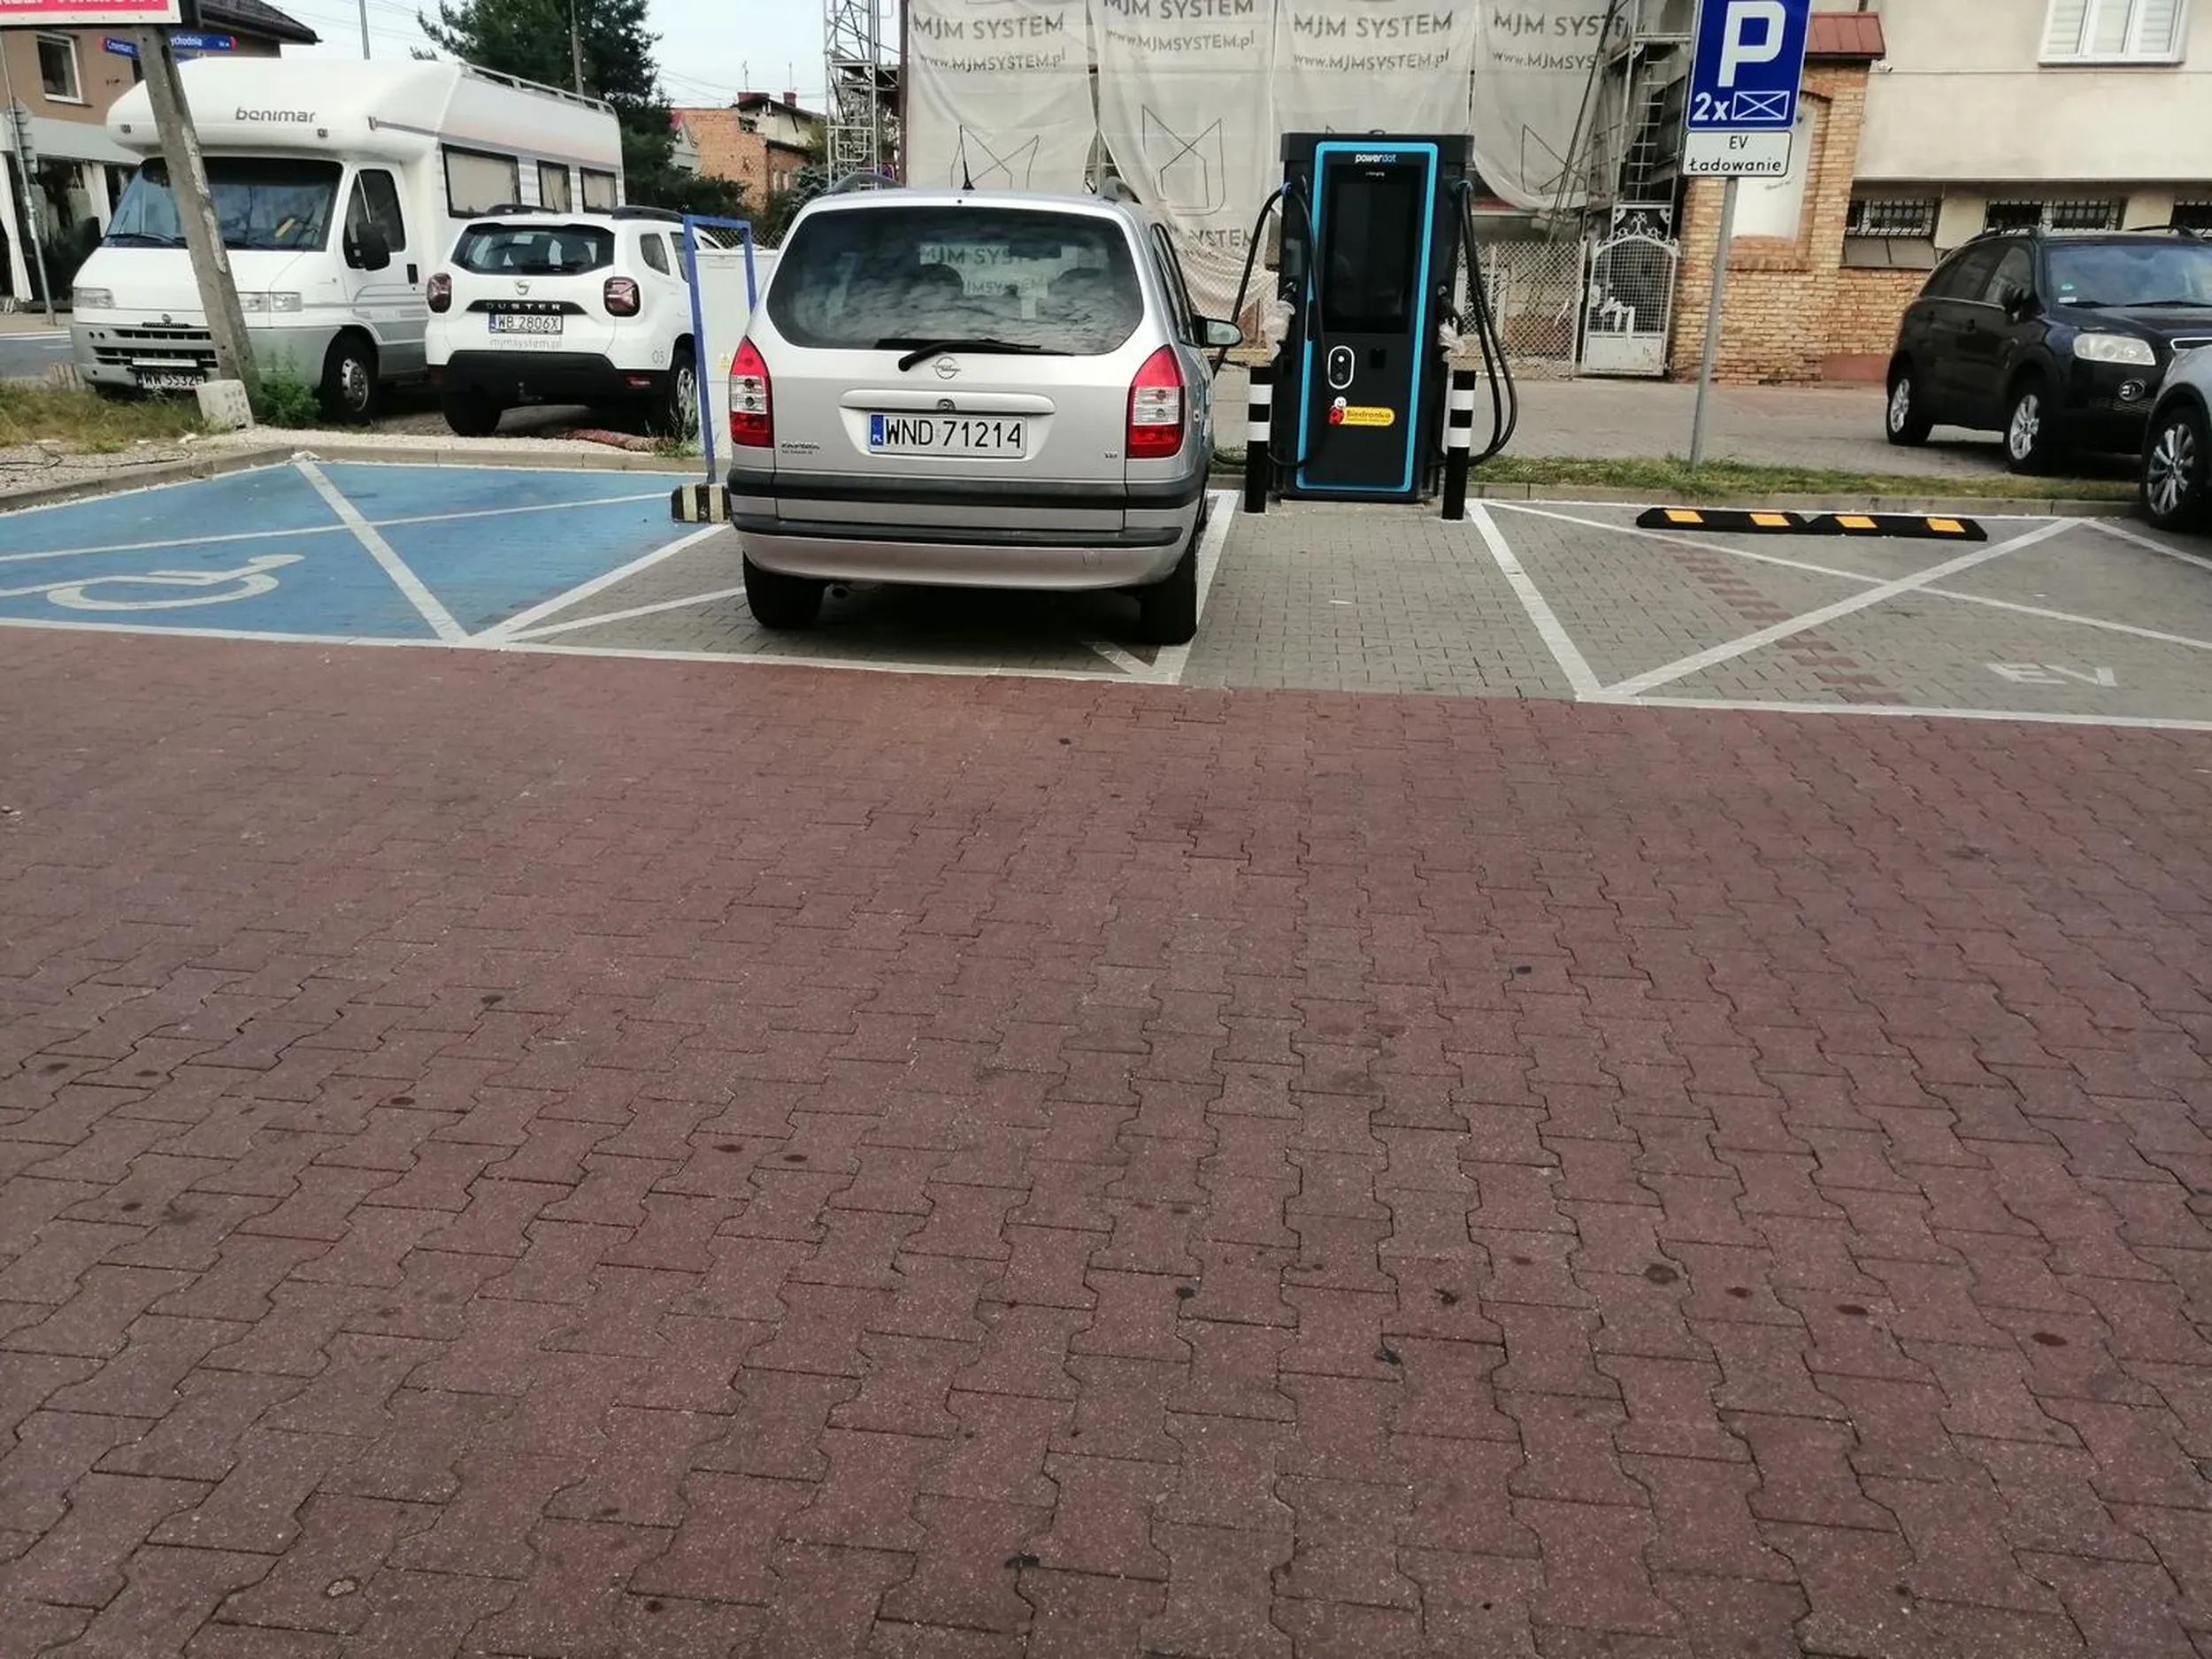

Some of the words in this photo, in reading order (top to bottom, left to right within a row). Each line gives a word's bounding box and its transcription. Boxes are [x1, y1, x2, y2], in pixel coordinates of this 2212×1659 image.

[1159, 0, 1254, 19] SYSTEM
[913, 12, 964, 39] MJM
[973, 12, 1064, 39] SYSTEM
[1294, 12, 1347, 38] MJM
[1356, 10, 1453, 38] SYSTEM
[1494, 7, 1546, 37] MJM
[1717, 2, 1786, 87] P
[1294, 49, 1449, 73] www.MJMSYSTEM.pl
[234, 107, 316, 123] benimar
[1729, 135, 1748, 149] EV
[1355, 153, 1396, 165] powerdot
[486, 302, 561, 311] DUSTER
[498, 315, 514, 329] WB
[519, 316, 559, 330] 2806X
[886, 419, 933, 446] WND
[943, 420, 1021, 449] 71214
